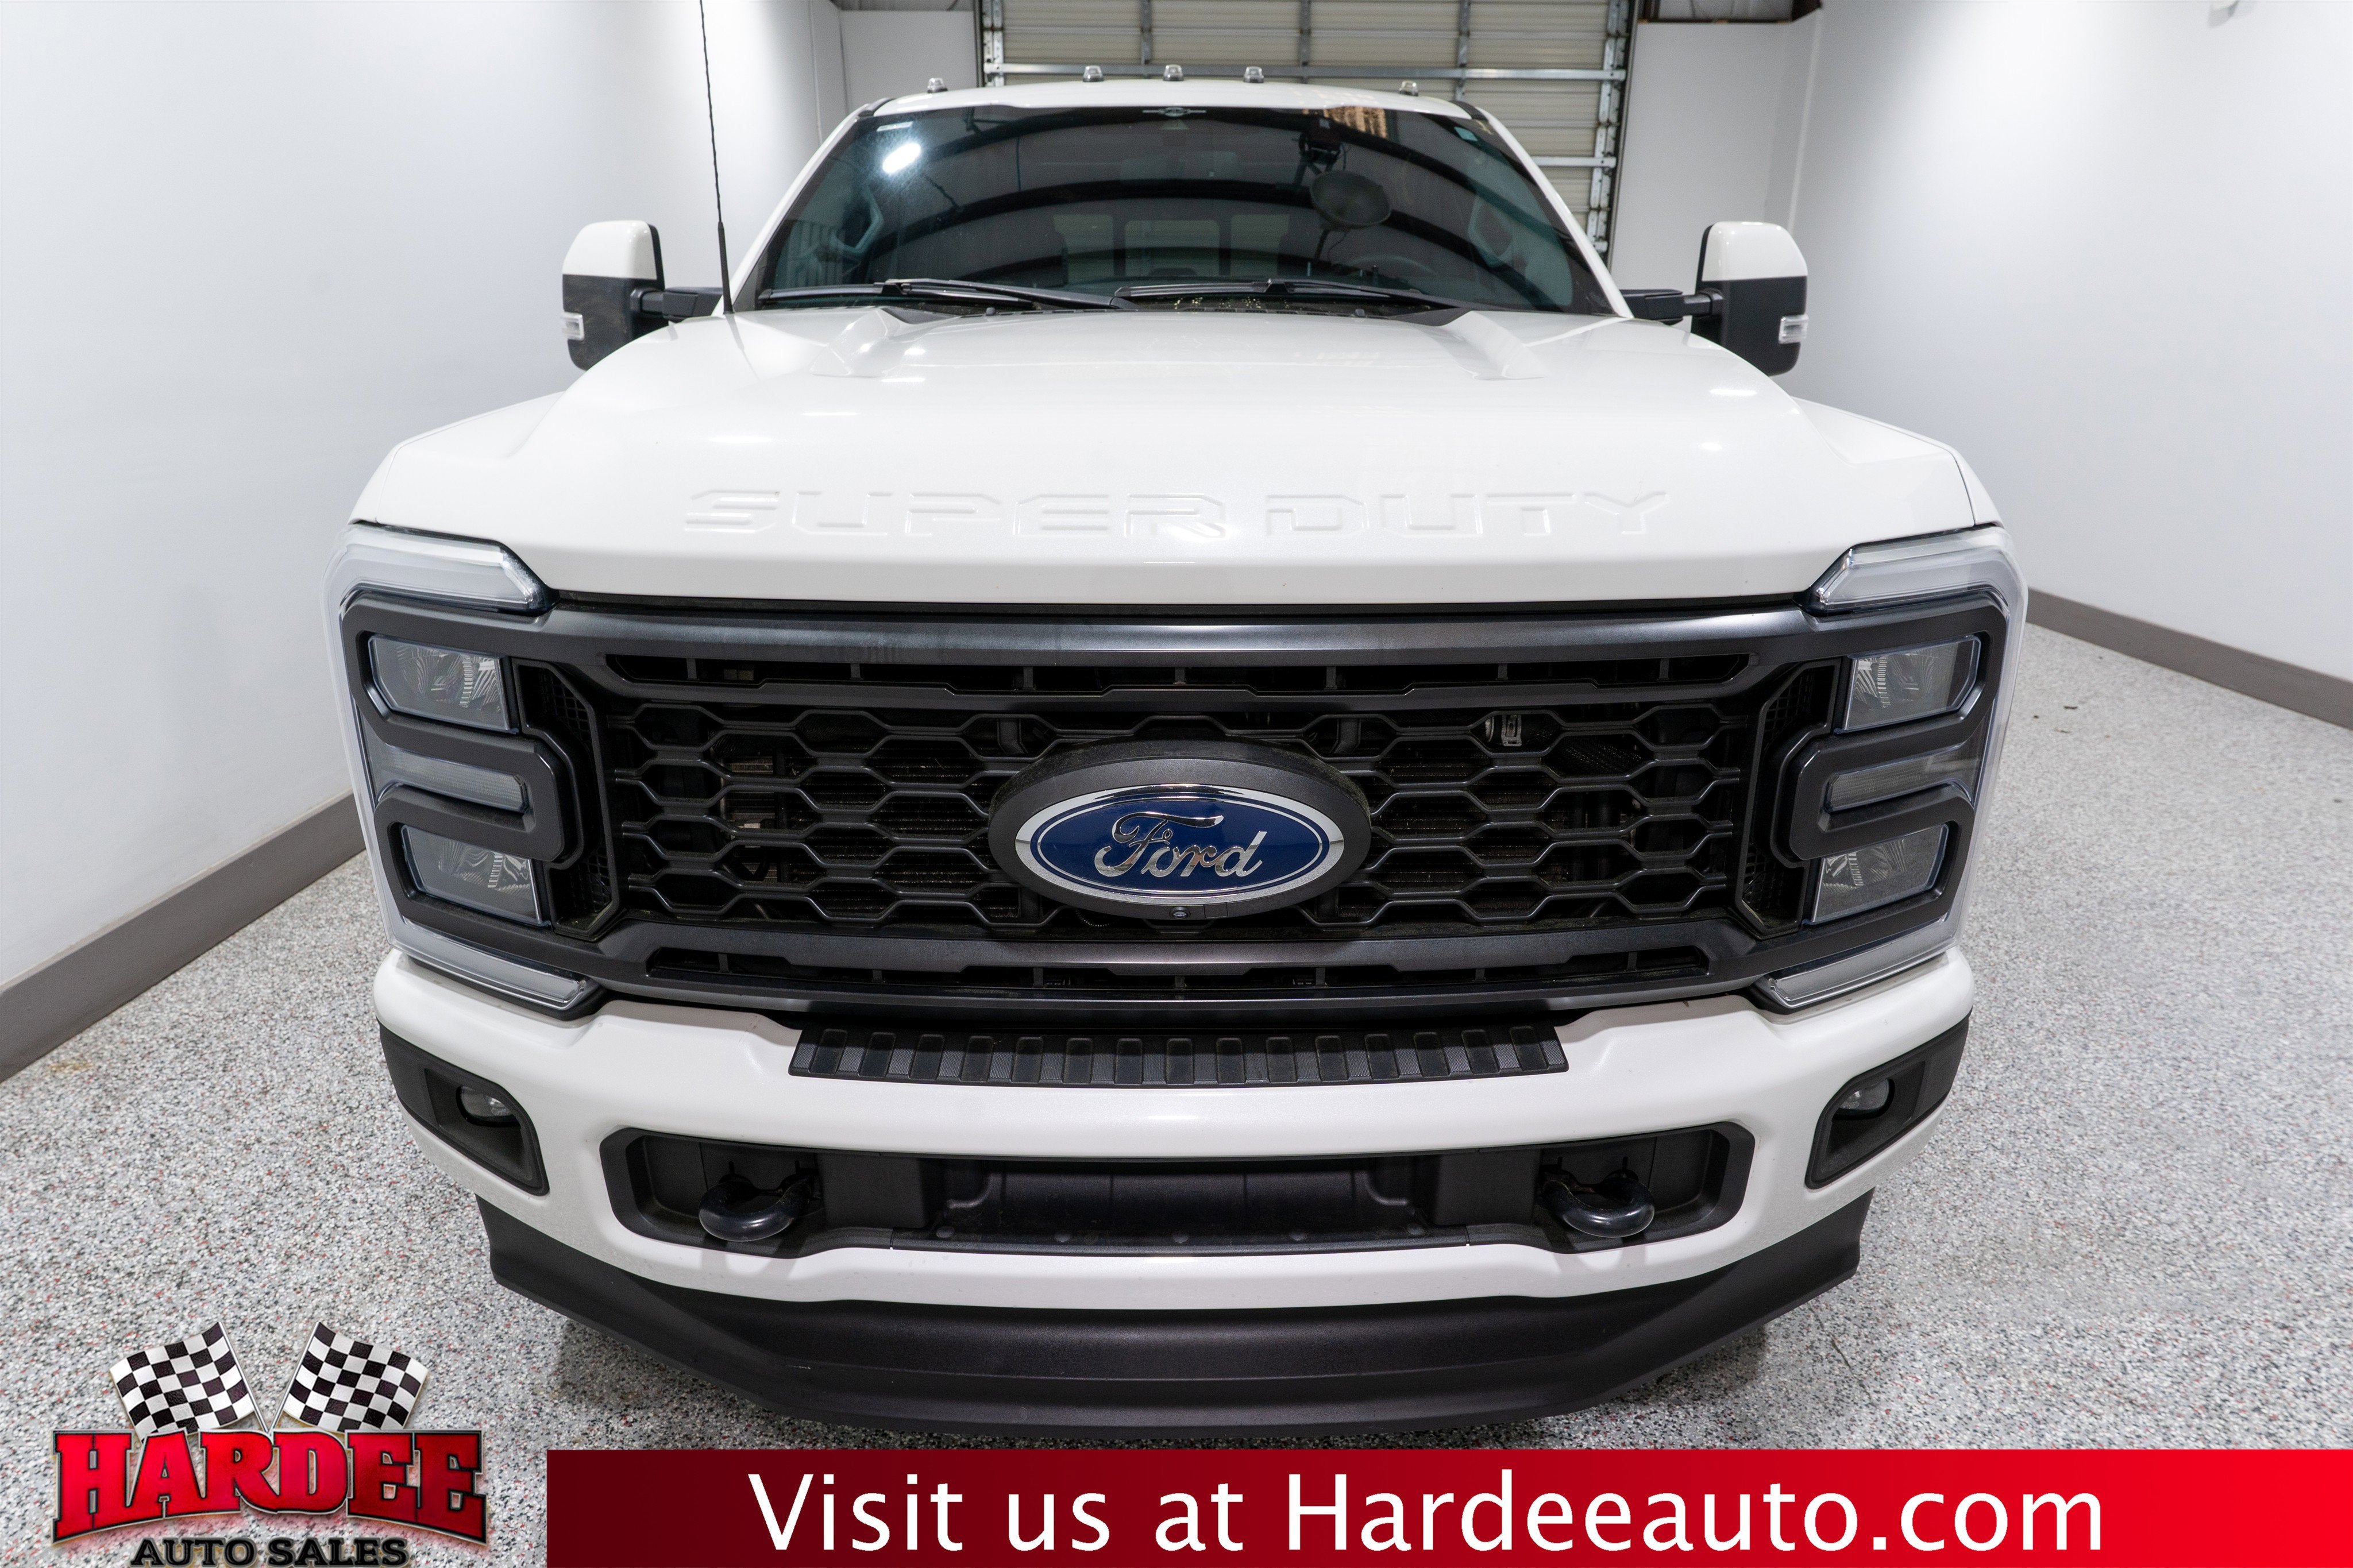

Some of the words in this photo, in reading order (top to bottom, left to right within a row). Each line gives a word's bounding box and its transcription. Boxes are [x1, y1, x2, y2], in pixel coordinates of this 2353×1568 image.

[684, 489, 1228, 540] SUPER
[1265, 490, 1671, 539] DUTY
[1094, 811, 1267, 878] Ford
